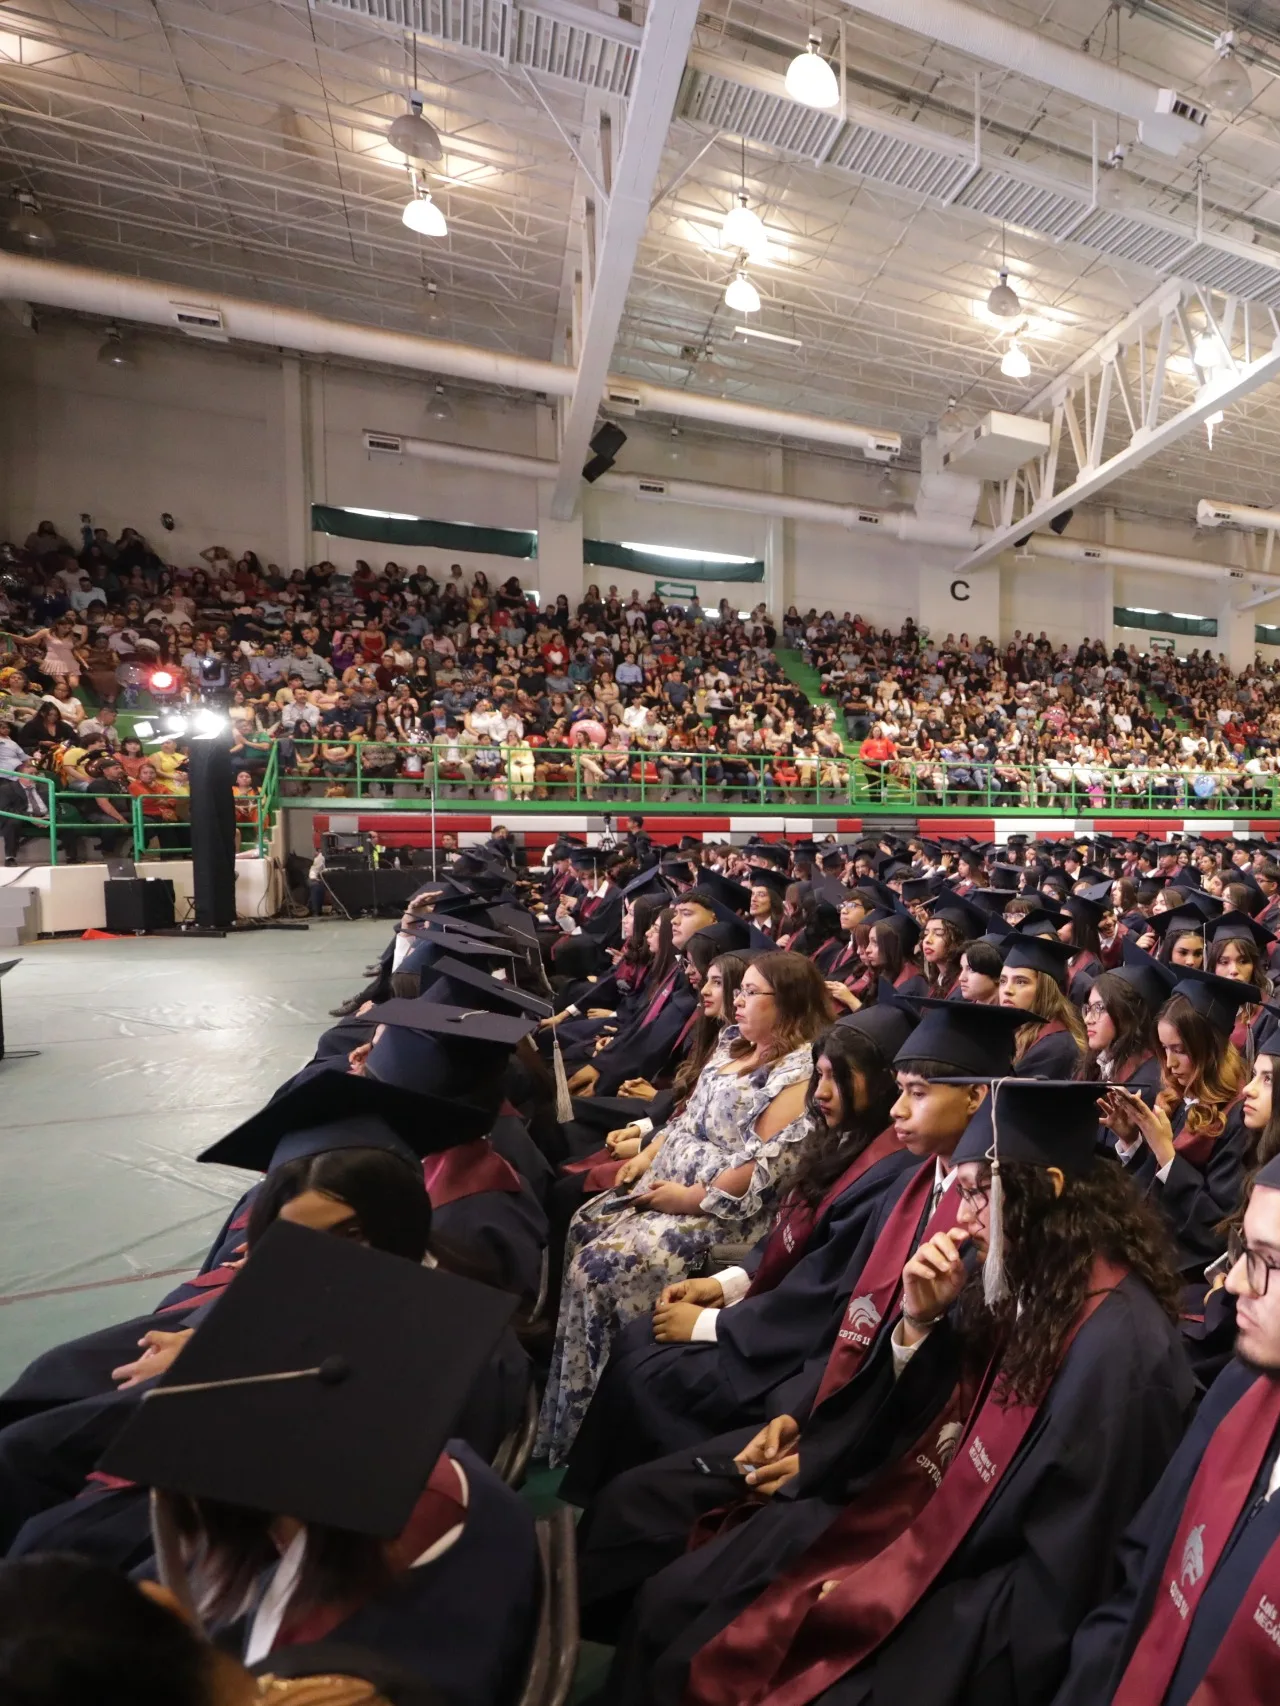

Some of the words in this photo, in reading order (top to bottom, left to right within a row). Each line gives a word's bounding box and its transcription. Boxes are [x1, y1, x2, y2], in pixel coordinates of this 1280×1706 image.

[950, 579, 971, 602] C
[838, 1329, 863, 1342] CBTIS
[915, 1454, 941, 1482] CBTIS
[1259, 1594, 1278, 1621] Luis
